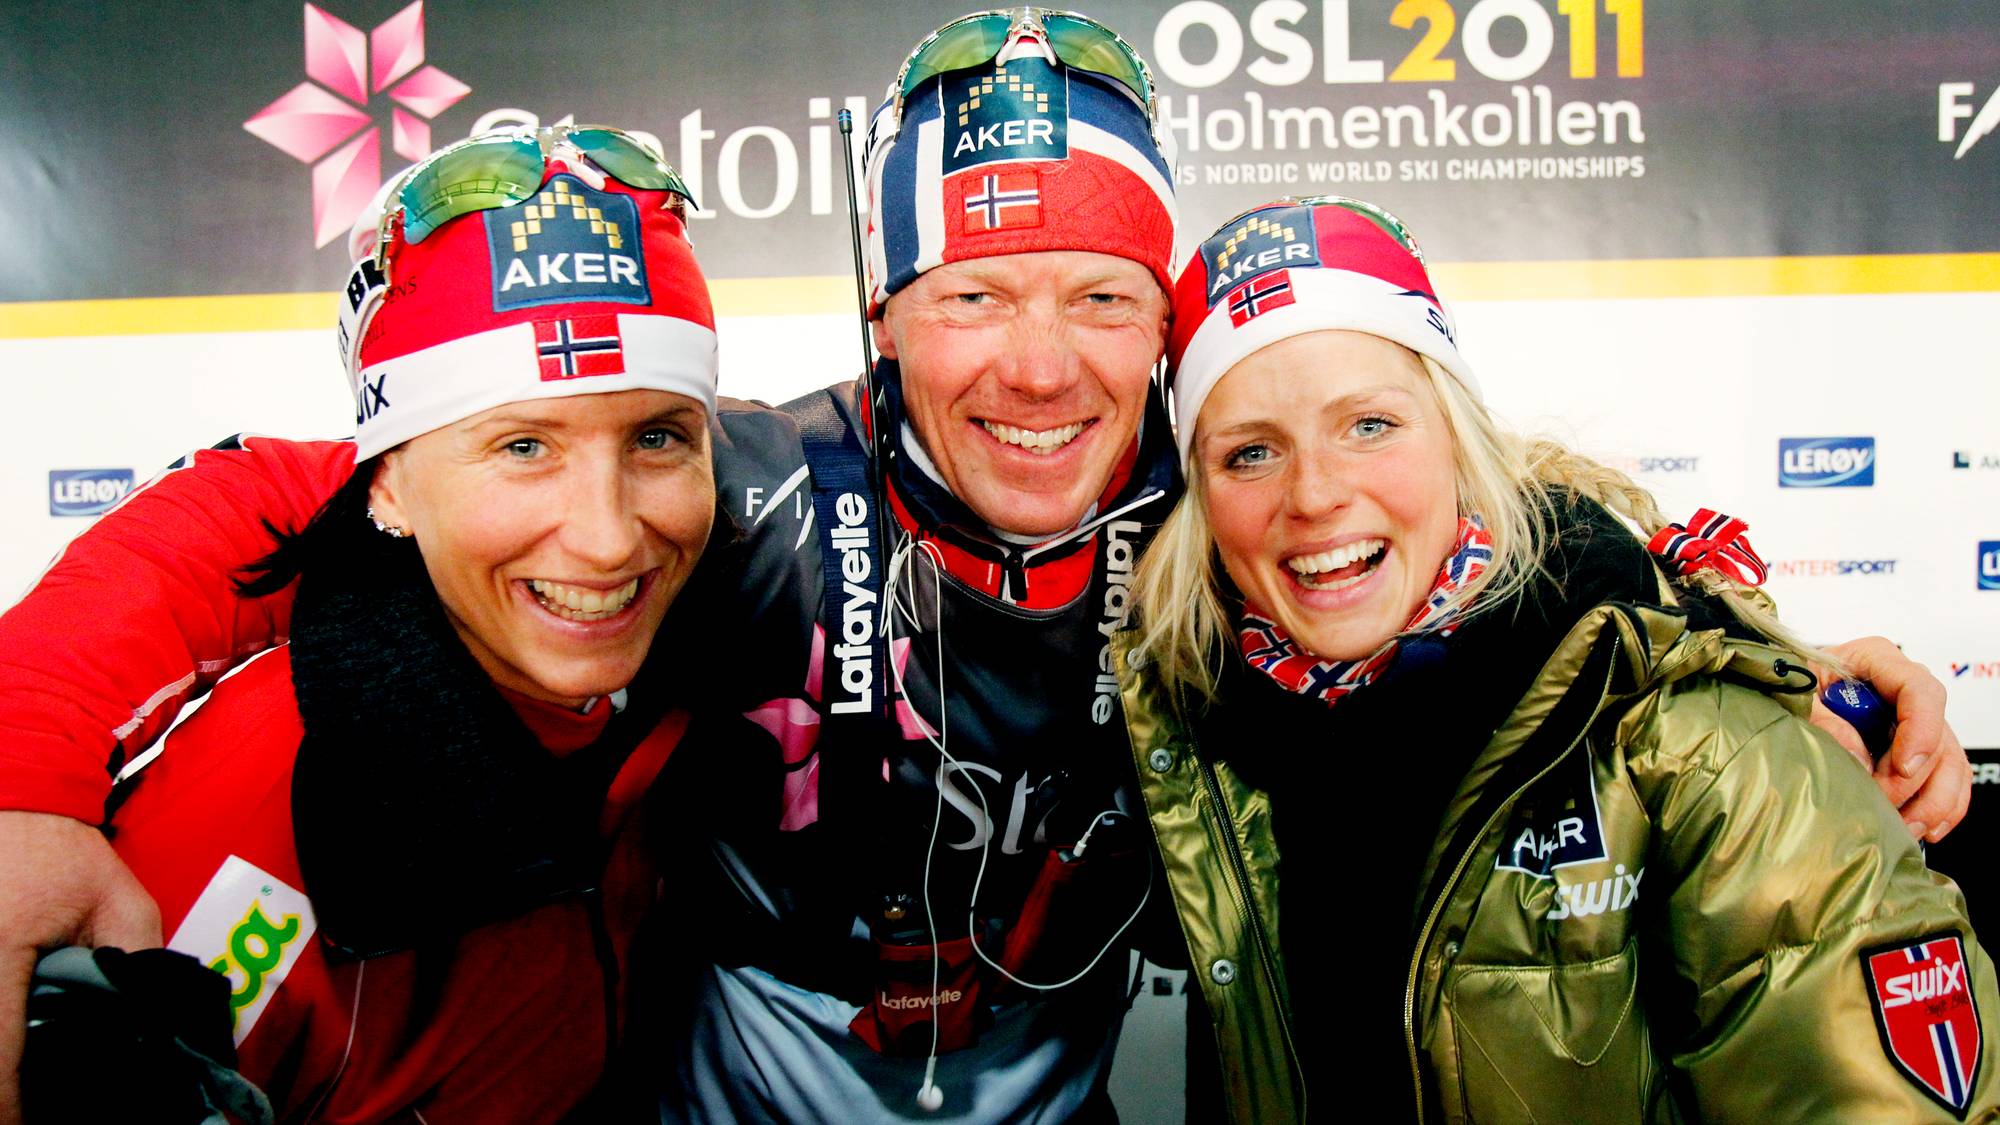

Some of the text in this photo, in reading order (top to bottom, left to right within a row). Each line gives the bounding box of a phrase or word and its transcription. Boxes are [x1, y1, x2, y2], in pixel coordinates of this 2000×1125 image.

[953, 119, 1054, 158] AKER
[1163, 85, 1646, 152] Holmenkollen
[1174, 155, 1646, 186] IS NORDIC WORLD SKI CHAMPIONSHIPS
[500, 252, 643, 292] AKER
[1208, 242, 1313, 298] AKER
[1775, 559, 1897, 577] INTERSPORT
[830, 492, 878, 714] Lafayette
